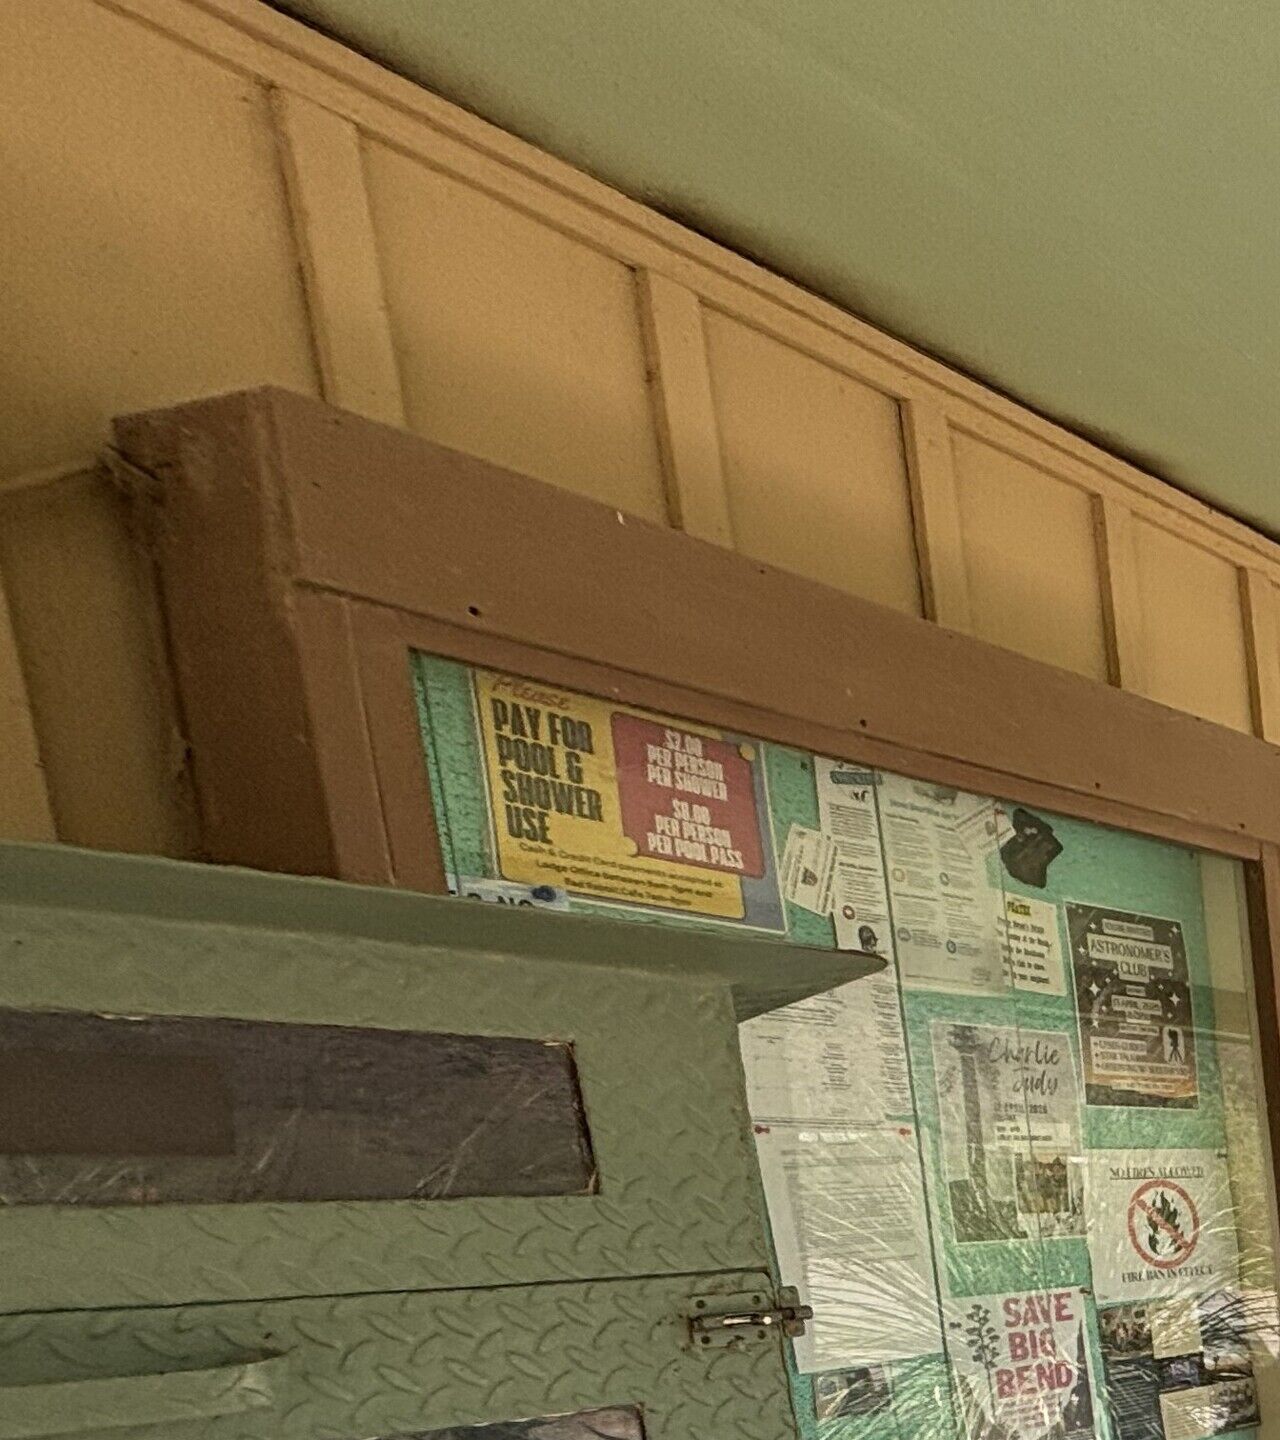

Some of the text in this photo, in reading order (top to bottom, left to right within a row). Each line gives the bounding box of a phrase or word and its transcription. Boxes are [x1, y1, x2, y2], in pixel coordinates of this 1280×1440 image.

[491, 698, 595, 755] PAY FOR
[495, 732, 584, 784] POOL &
[647, 743, 724, 783] PER PERSON
[500, 769, 604, 823] SHOWER
[647, 764, 728, 801] PER SHOWER
[505, 804, 553, 844] USE
[655, 814, 732, 850] PER PERSON
[647, 832, 744, 870] PER POOL PASS
[1090, 940, 1172, 964] ASTRONOMER'S
[1119, 961, 1148, 977] CLUB
[986, 1036, 1060, 1066] Charlie
[1012, 1066, 1058, 1096] Judy
[1126, 1166, 1156, 1178] FIRES
[1158, 1165, 1204, 1179] ALLOWED
[1122, 1271, 1143, 1283] FIRE
[1146, 1269, 1165, 1281] BAN
[1178, 1264, 1213, 1277] EFFECT
[1003, 1292, 1075, 1328] SAVE
[1008, 1327, 1057, 1362] BIG
[995, 1360, 1073, 1400] BEND
